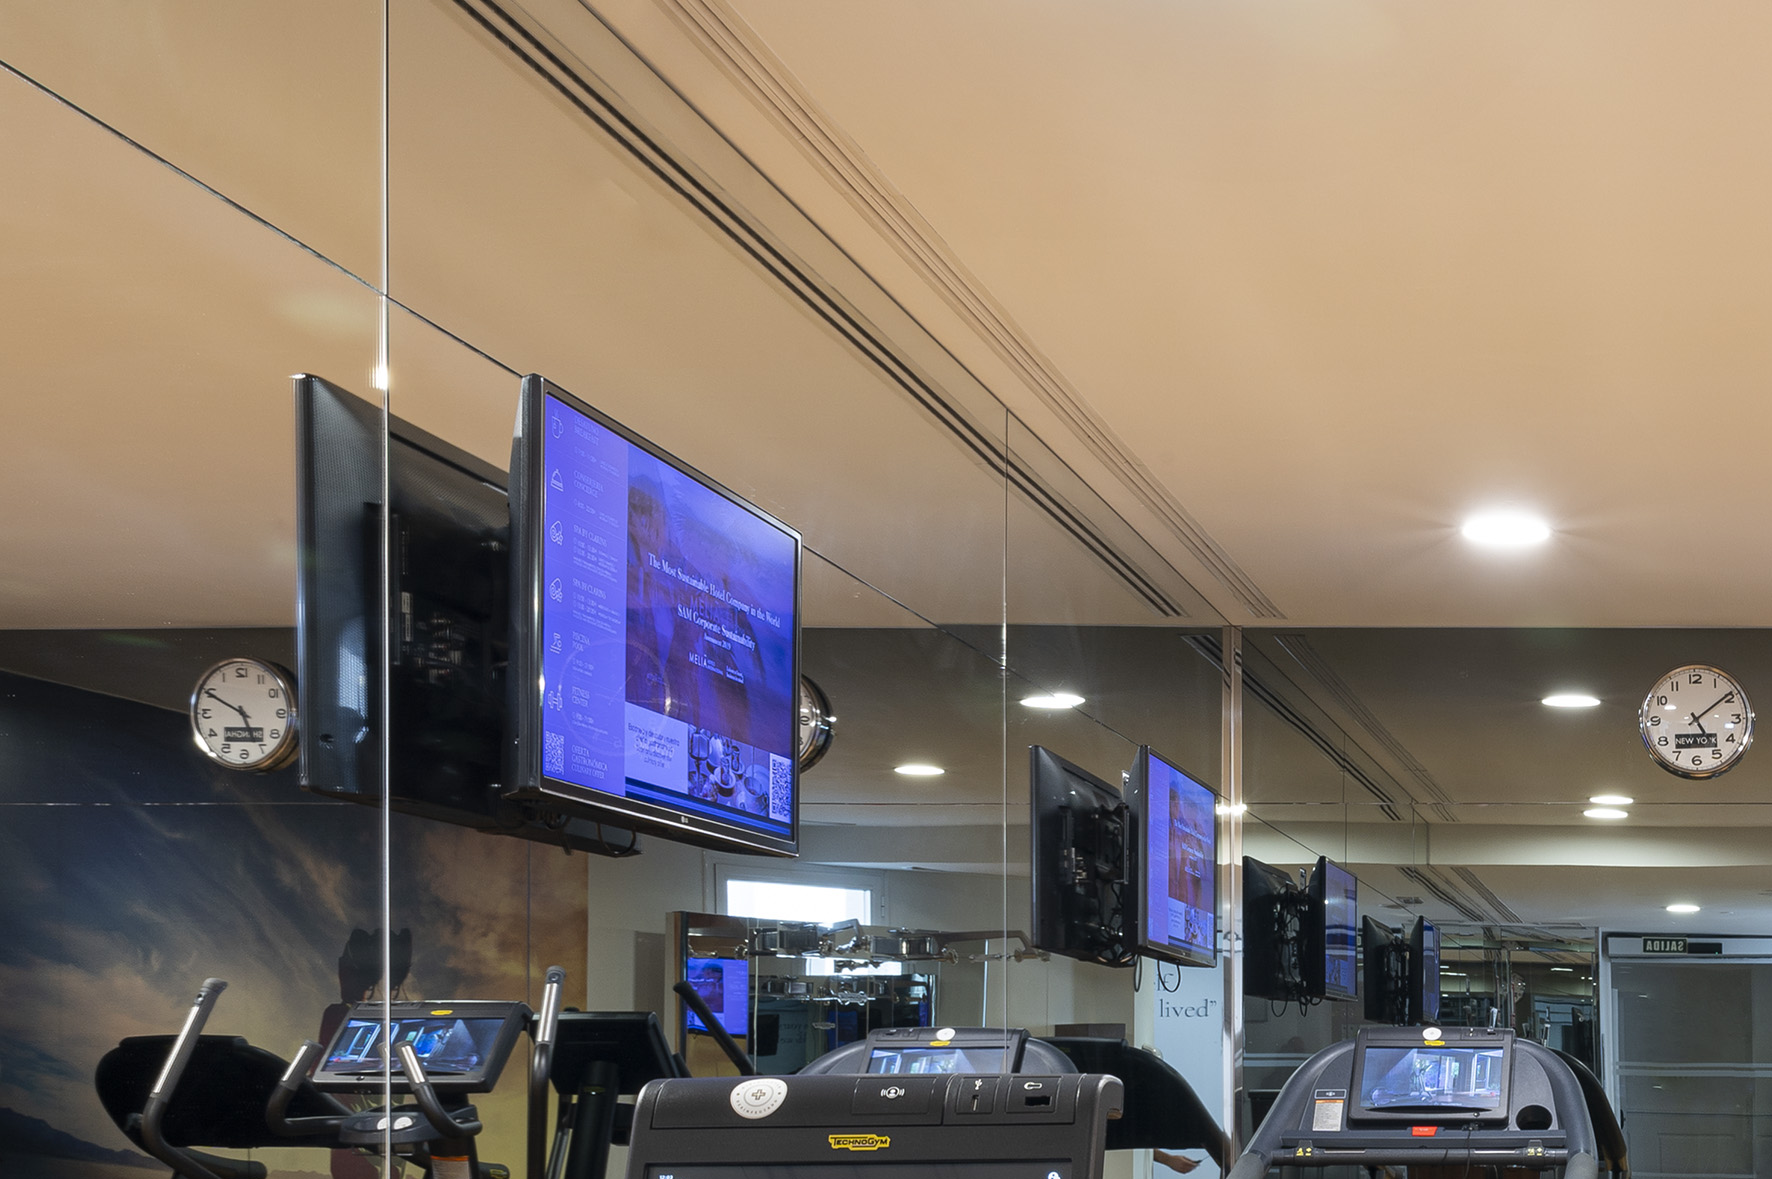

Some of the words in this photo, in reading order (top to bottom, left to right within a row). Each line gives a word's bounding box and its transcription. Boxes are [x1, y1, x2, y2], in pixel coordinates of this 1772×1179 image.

[648, 552, 660, 569] The
[662, 560, 676, 578] Most
[677, 567, 709, 593] Sustainable
[710, 583, 725, 602] Hotel
[726, 591, 749, 615] Company
[750, 604, 756, 615] in
[757, 608, 765, 621] the
[766, 610, 780, 628] World
[677, 603, 692, 621] SAM
[693, 612, 721, 635] Corporate
[1689, 674, 1702, 684] 12
[1714, 679, 1717, 688] 1
[1671, 681, 1678, 691] 11
[1657, 696, 1668, 706] 10
[1725, 692, 1734, 703] 2
[1650, 716, 1660, 726] 9
[1731, 714, 1741, 724] 3
[1658, 736, 1669, 746] 8
[1726, 733, 1736, 744] 4
[1672, 751, 1681, 761] 7
[1712, 749, 1722, 759] 5
[1692, 756, 1702, 766] 6
